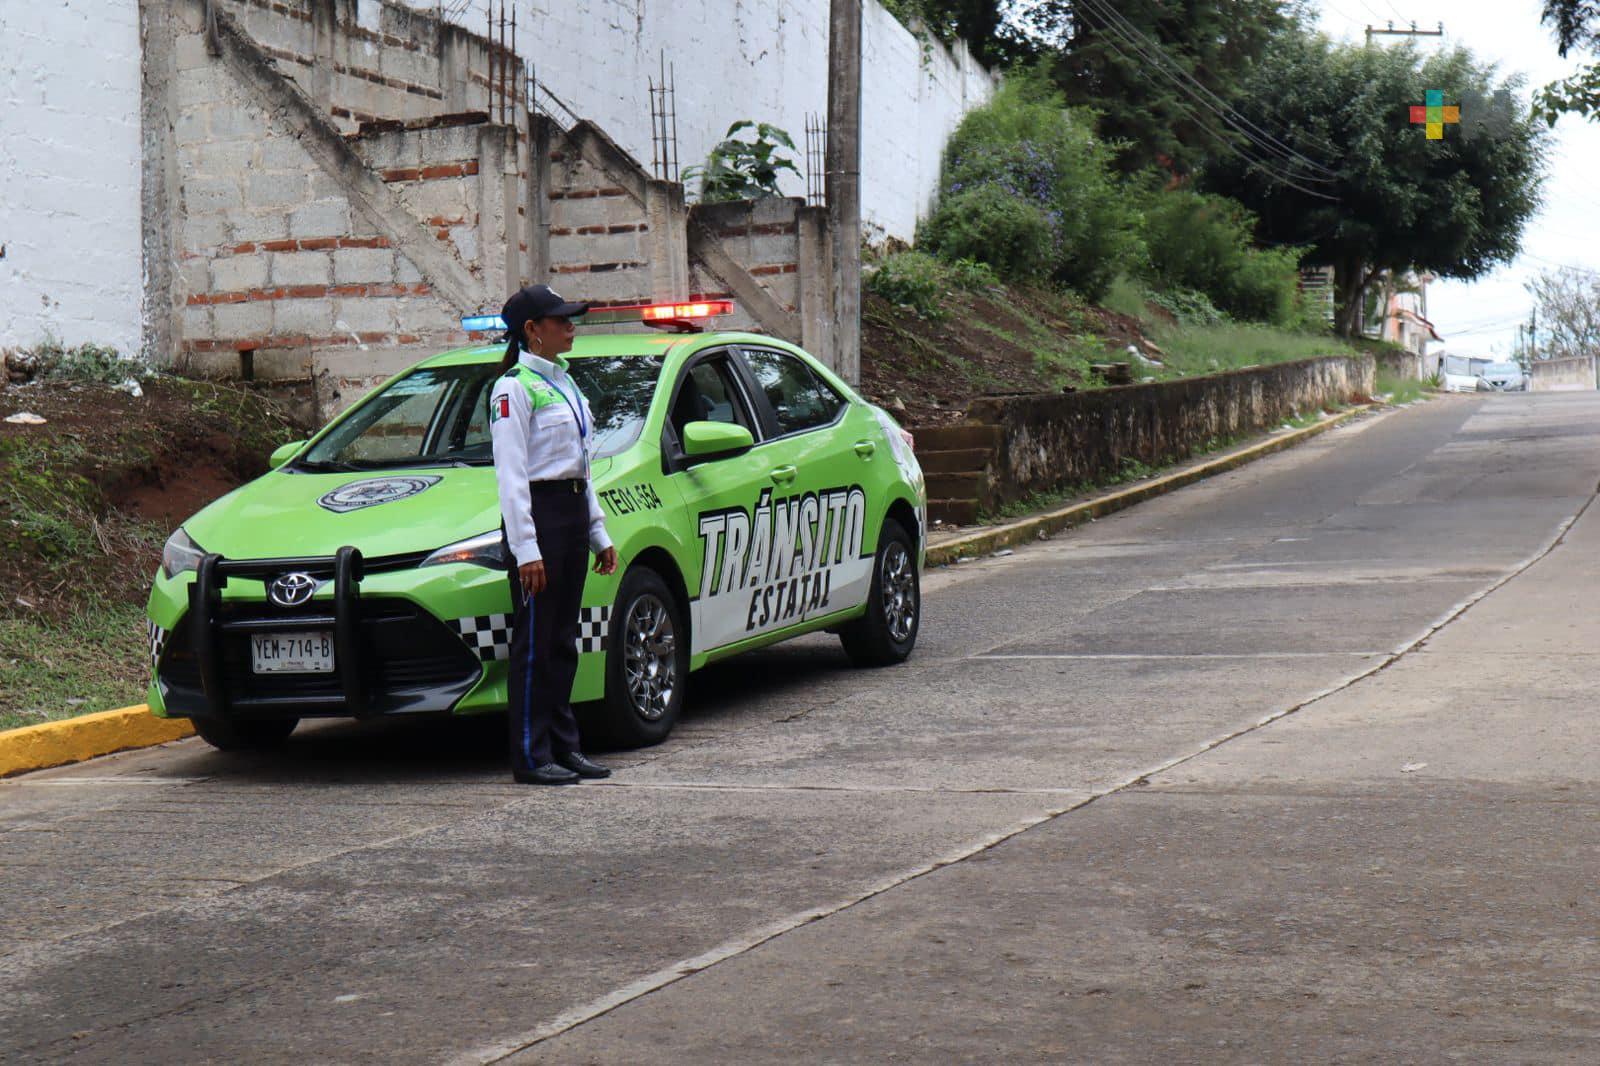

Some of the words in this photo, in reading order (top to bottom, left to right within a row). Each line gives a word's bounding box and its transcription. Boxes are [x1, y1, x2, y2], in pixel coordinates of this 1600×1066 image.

[598, 482, 664, 517] TE01-554
[697, 484, 867, 600] TRÁNSITO
[745, 569, 831, 631] ESTATAL
[255, 638, 330, 659] YEM-714-B
